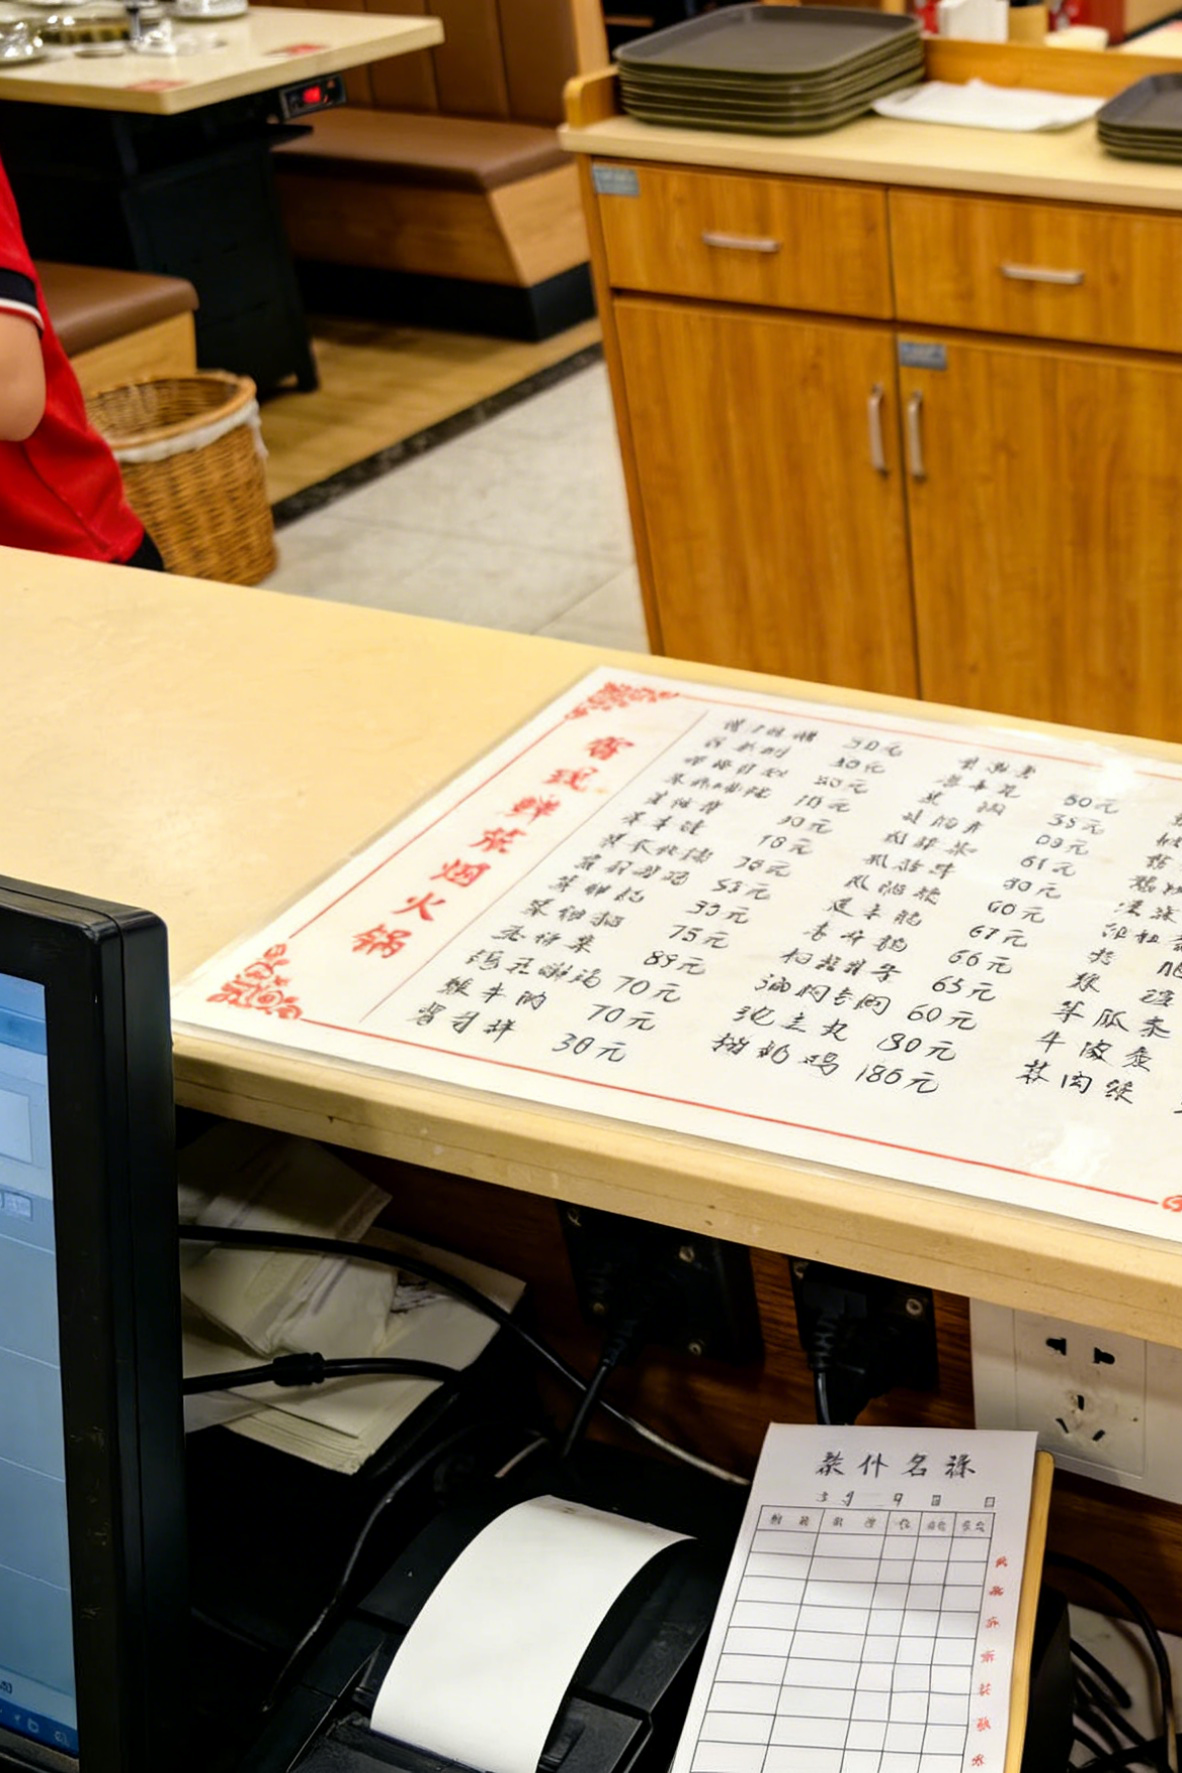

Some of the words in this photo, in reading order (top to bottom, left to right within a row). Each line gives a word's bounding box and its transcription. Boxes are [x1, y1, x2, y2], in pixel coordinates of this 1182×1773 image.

[613, 975, 681, 1004] 70元
[586, 1003, 656, 1032] 70元
[906, 1003, 977, 1031] 60元
